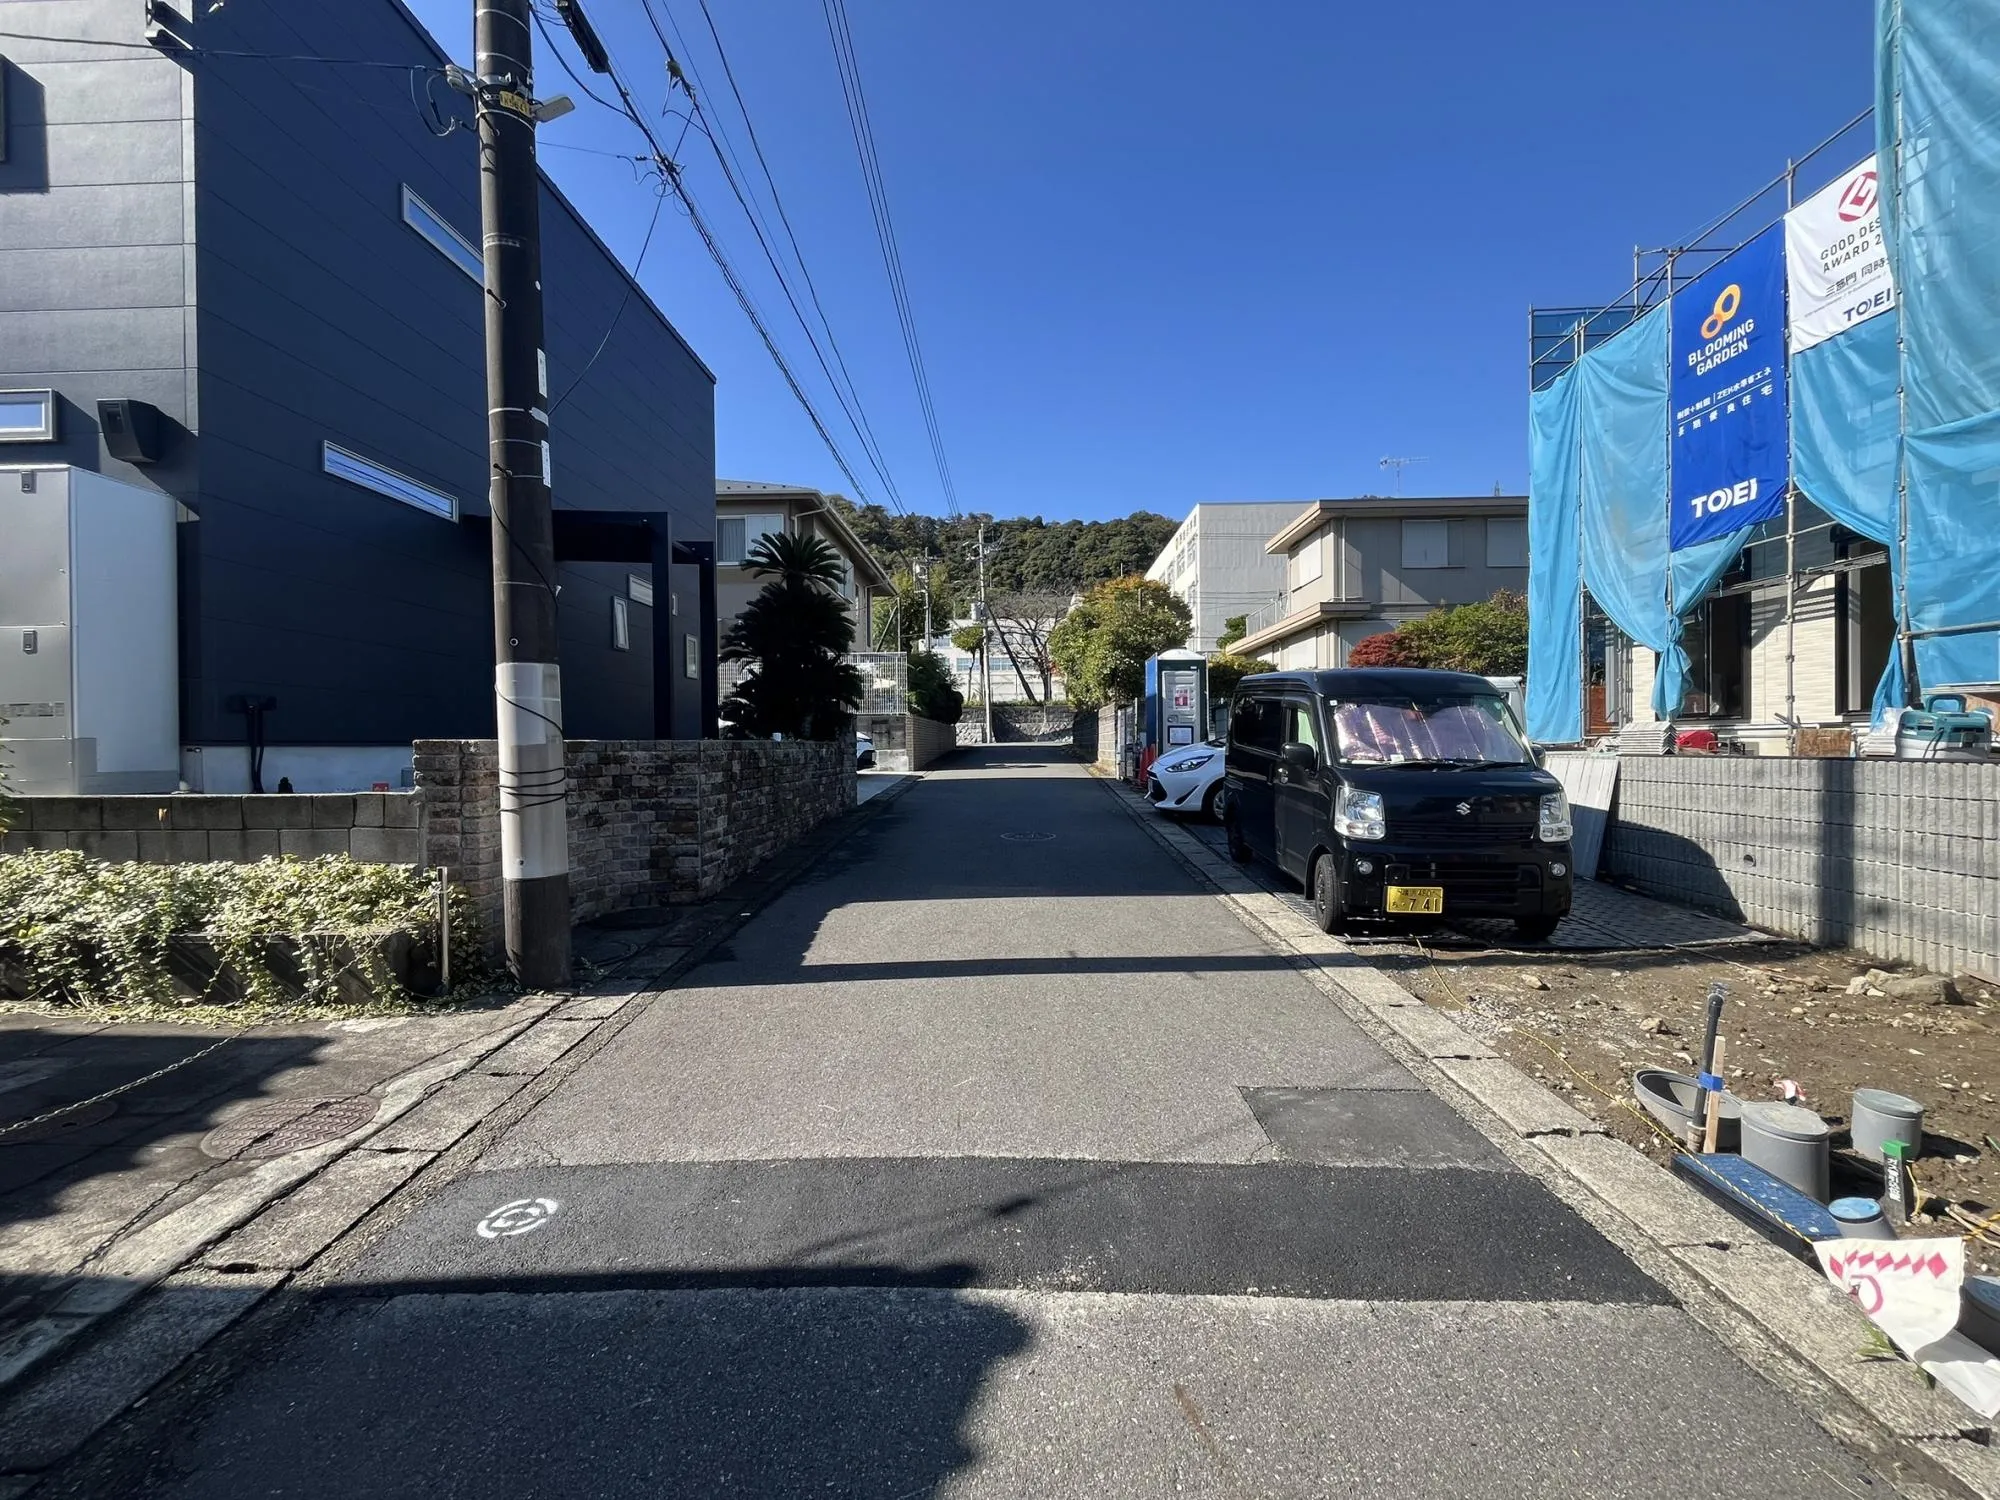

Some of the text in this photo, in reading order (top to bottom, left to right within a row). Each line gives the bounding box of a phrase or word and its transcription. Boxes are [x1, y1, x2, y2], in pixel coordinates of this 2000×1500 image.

[1820, 234, 1855, 261] GOOD
[1823, 240, 1870, 274] AWARD
[1843, 287, 1891, 322] TOEI
[1688, 318, 1755, 367] BLOOMING
[1696, 338, 1748, 377] GARDEN
[1691, 477, 1758, 519] TOEI
